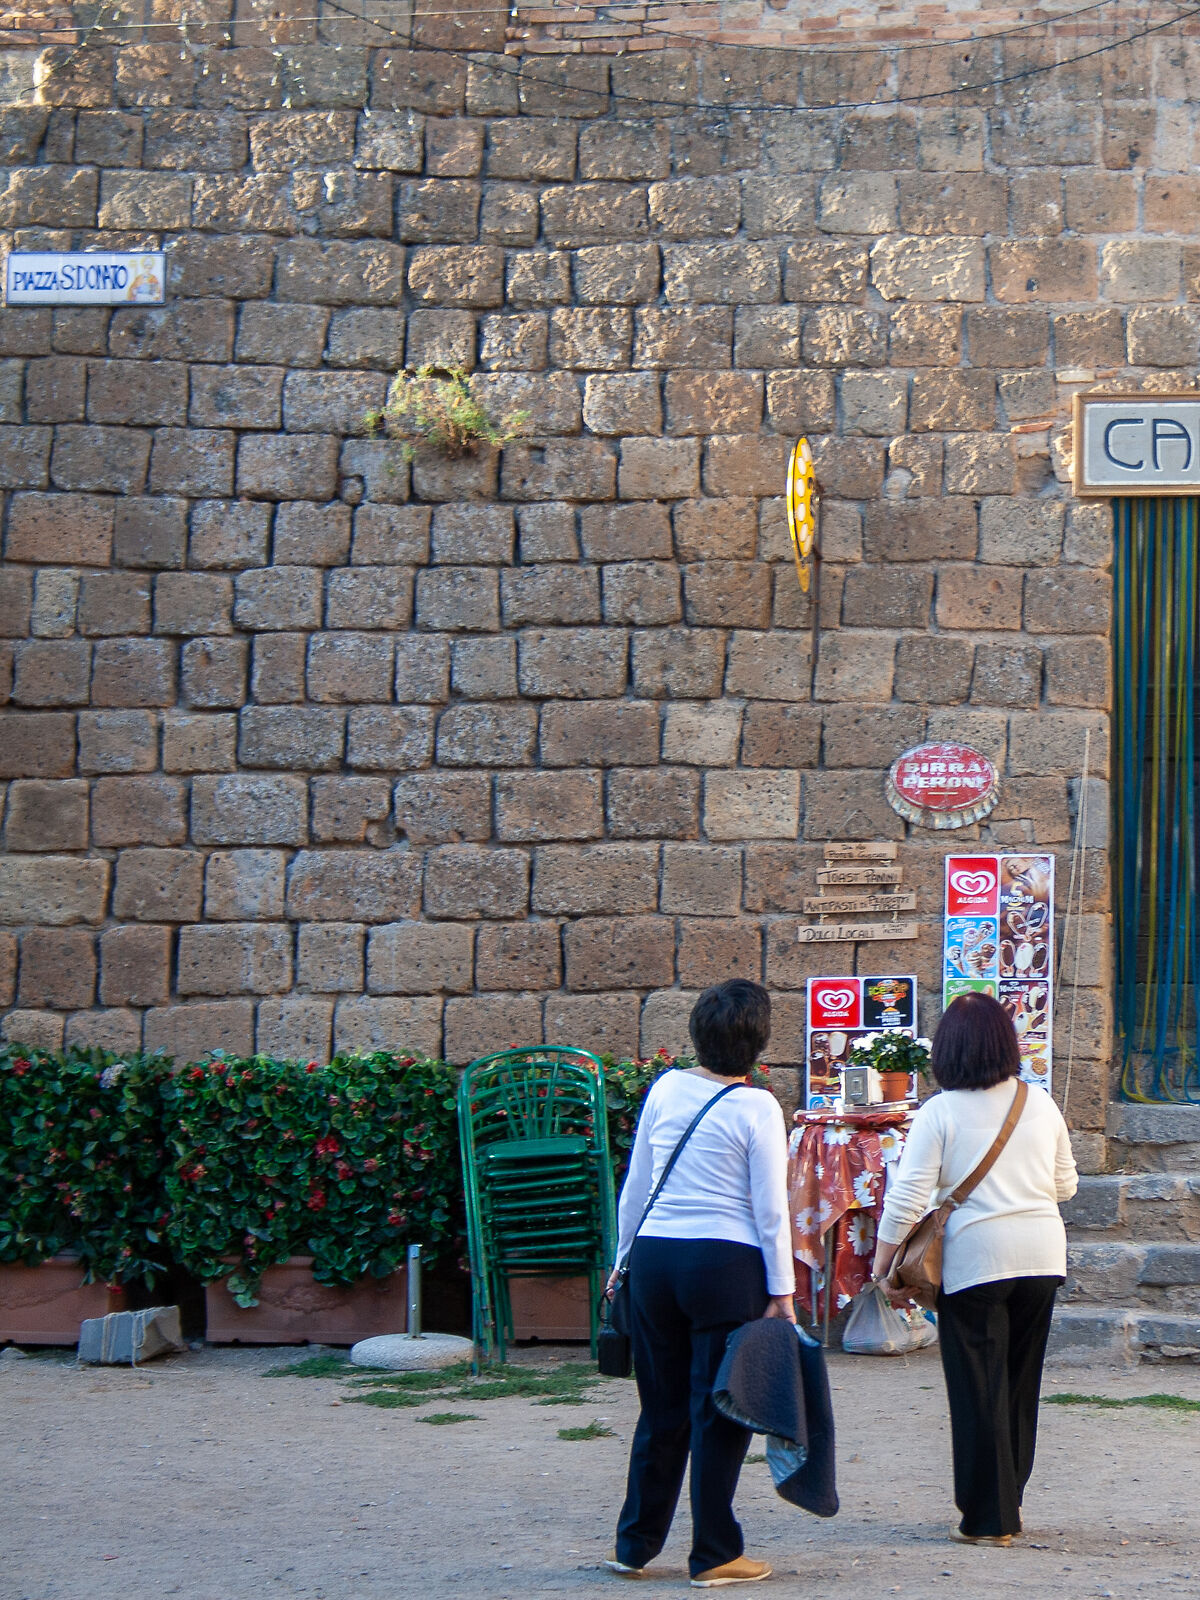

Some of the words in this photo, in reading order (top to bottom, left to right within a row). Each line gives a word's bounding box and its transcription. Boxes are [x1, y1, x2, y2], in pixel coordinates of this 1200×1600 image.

[12, 271, 59, 291] PIAZZA
[903, 762, 983, 773] BIRRA
[902, 776, 985, 789] PERONI
[817, 868, 860, 883] TOAST
[863, 868, 898, 884] PANINI
[957, 896, 989, 904] ALGIDA
[838, 927, 874, 939] LOCALI
